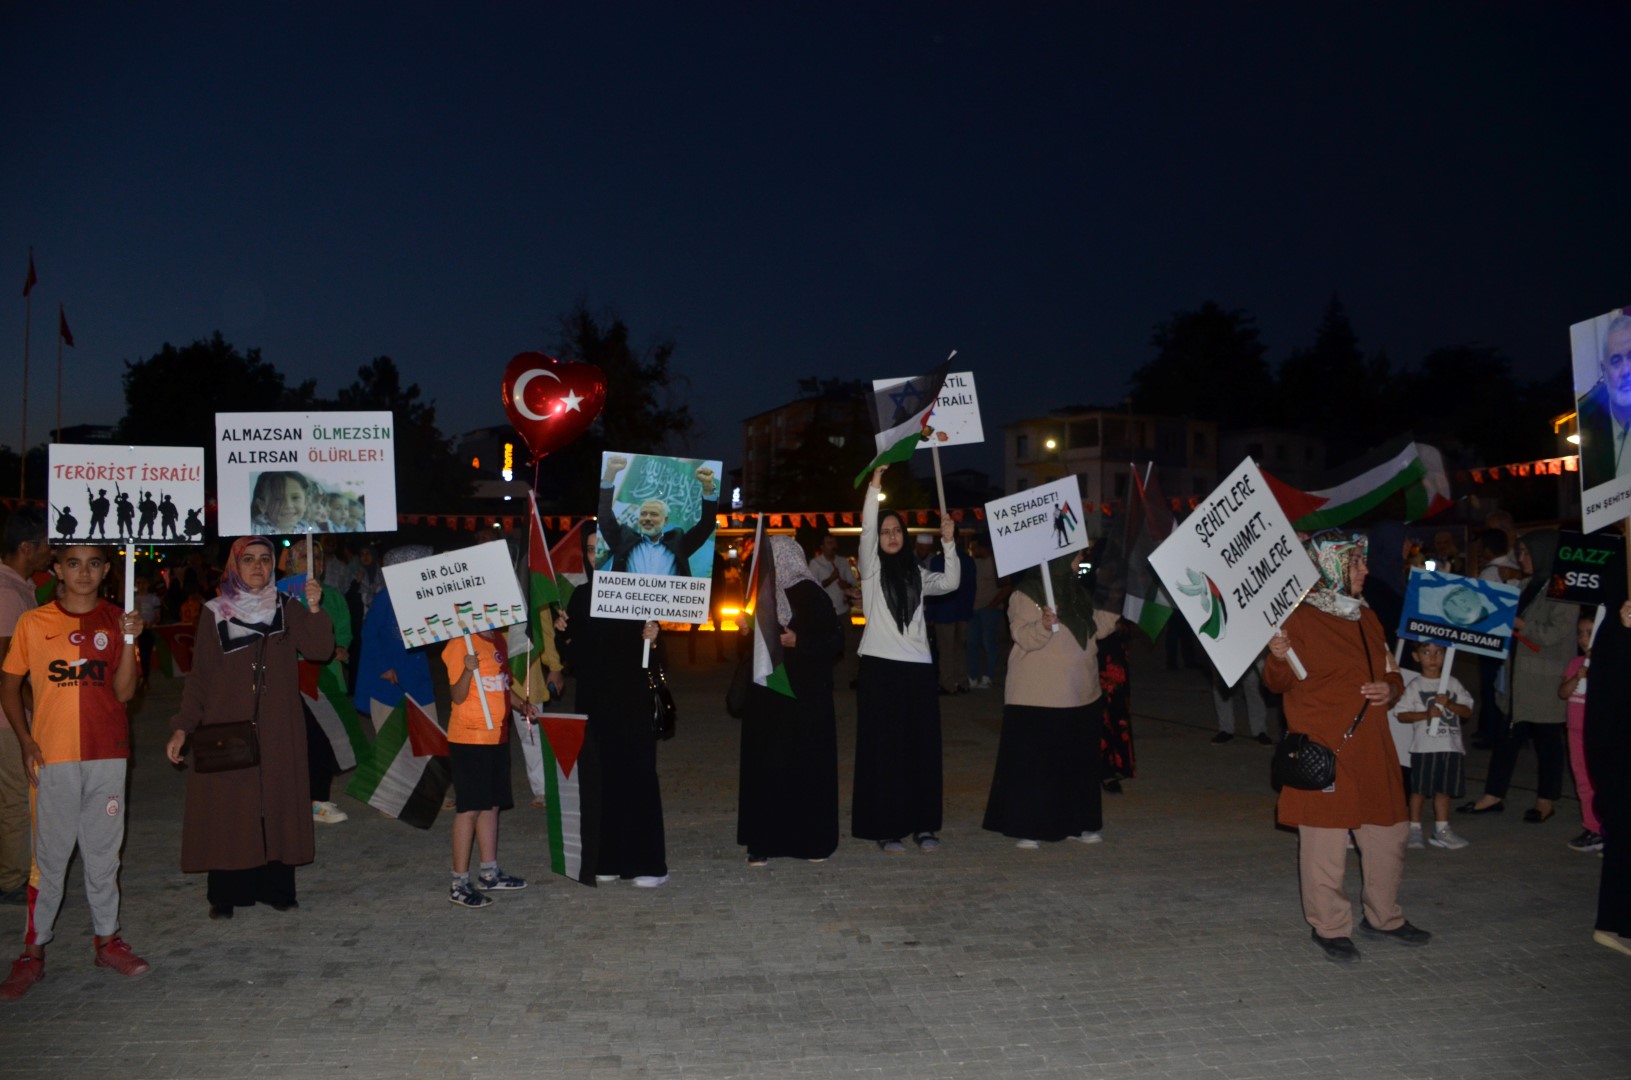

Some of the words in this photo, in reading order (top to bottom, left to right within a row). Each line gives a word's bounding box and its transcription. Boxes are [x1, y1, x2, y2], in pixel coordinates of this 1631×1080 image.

[936, 393, 973, 407] TRAİL!
[222, 428, 302, 441] ALMAZSAN
[313, 424, 390, 440] ÖLMEZSİN
[228, 450, 298, 464] ALIRSAN
[308, 447, 384, 462] ÖLÜRLER!
[54, 462, 137, 480] TERÖRİST
[141, 463, 200, 481] İSRAİL!
[993, 509, 1008, 520] YA
[1010, 491, 1059, 517] ŞEHADET!
[1587, 503, 1601, 515] SEN
[1604, 488, 1631, 510] ŞEHİTS
[1195, 474, 1255, 548] ŞEHİTLERE
[997, 525, 1012, 537] YA
[1013, 513, 1048, 532] ZAFER!
[1558, 546, 1614, 564] GAZZ
[420, 568, 437, 581] BİR
[440, 562, 468, 576] ÖLÜR
[1232, 534, 1292, 609] ZALİMLERE
[1564, 571, 1600, 589] SES
[598, 576, 636, 586] MADEM
[638, 577, 667, 588] ÖLÜM
[670, 580, 688, 590] TEK
[690, 581, 706, 591] BİR
[416, 587, 434, 600] BİN
[597, 590, 622, 599] DEFA
[625, 591, 670, 604] GELECEK,
[672, 595, 705, 605] NEDEN
[1263, 574, 1303, 627] LANET!
[597, 604, 629, 614] ALLAH
[631, 605, 651, 616] İÇİN
[653, 607, 704, 618] OLMASIN?
[1410, 621, 1458, 640] BOYKOTA
[1459, 632, 1501, 648] DEVAM!
